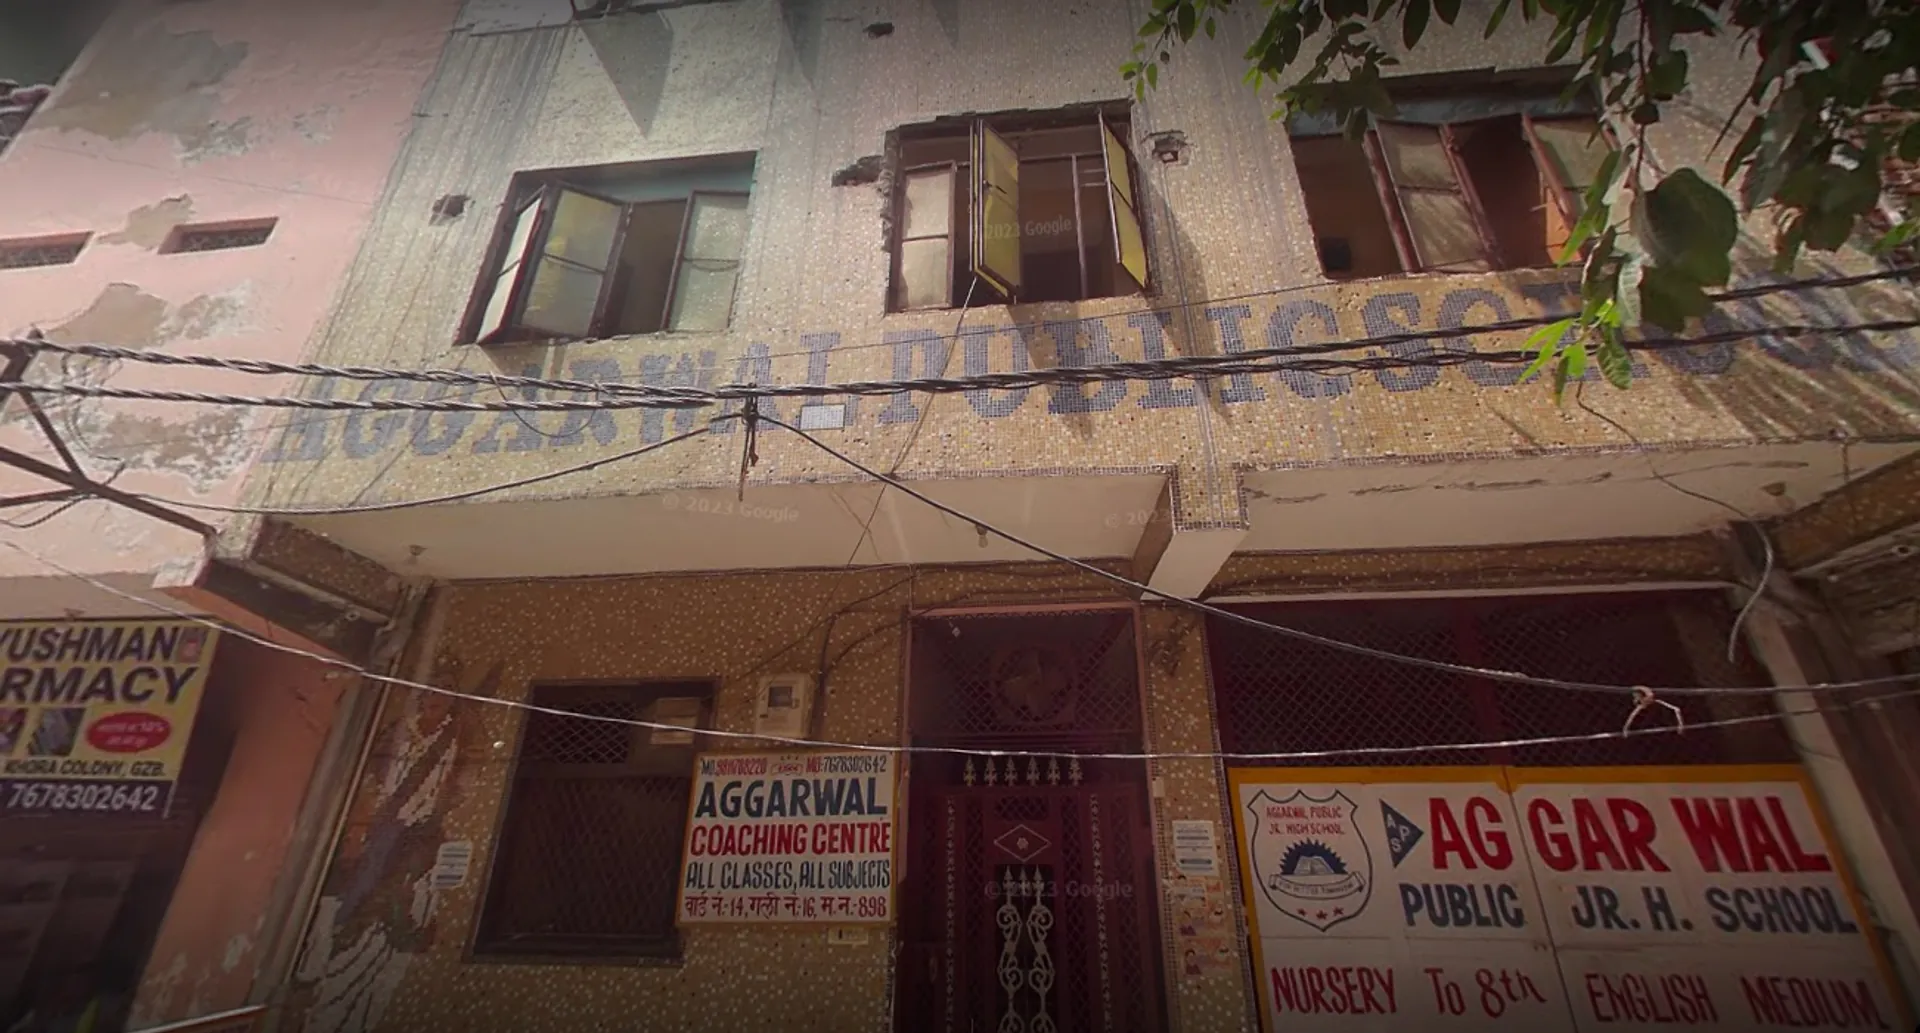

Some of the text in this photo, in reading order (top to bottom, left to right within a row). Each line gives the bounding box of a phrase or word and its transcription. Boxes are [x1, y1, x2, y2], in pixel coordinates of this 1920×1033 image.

[878, 303, 1352, 425] PUBLIC
[0, 666, 198, 703] RMACY
[6, 783, 159, 811] 7678302642
[694, 777, 887, 818] AGGARWAL
[690, 822, 891, 857] COACHING CENTRE
[686, 858, 890, 892] ALL CLASSES, ALL SUBJECTS
[750, 890, 780, 919] गली
[1399, 883, 1860, 934] PUBLIC JR. H. SCHOOL
[1271, 966, 1892, 1031] NURSERY To 8th ENGLISH MEDIUM
